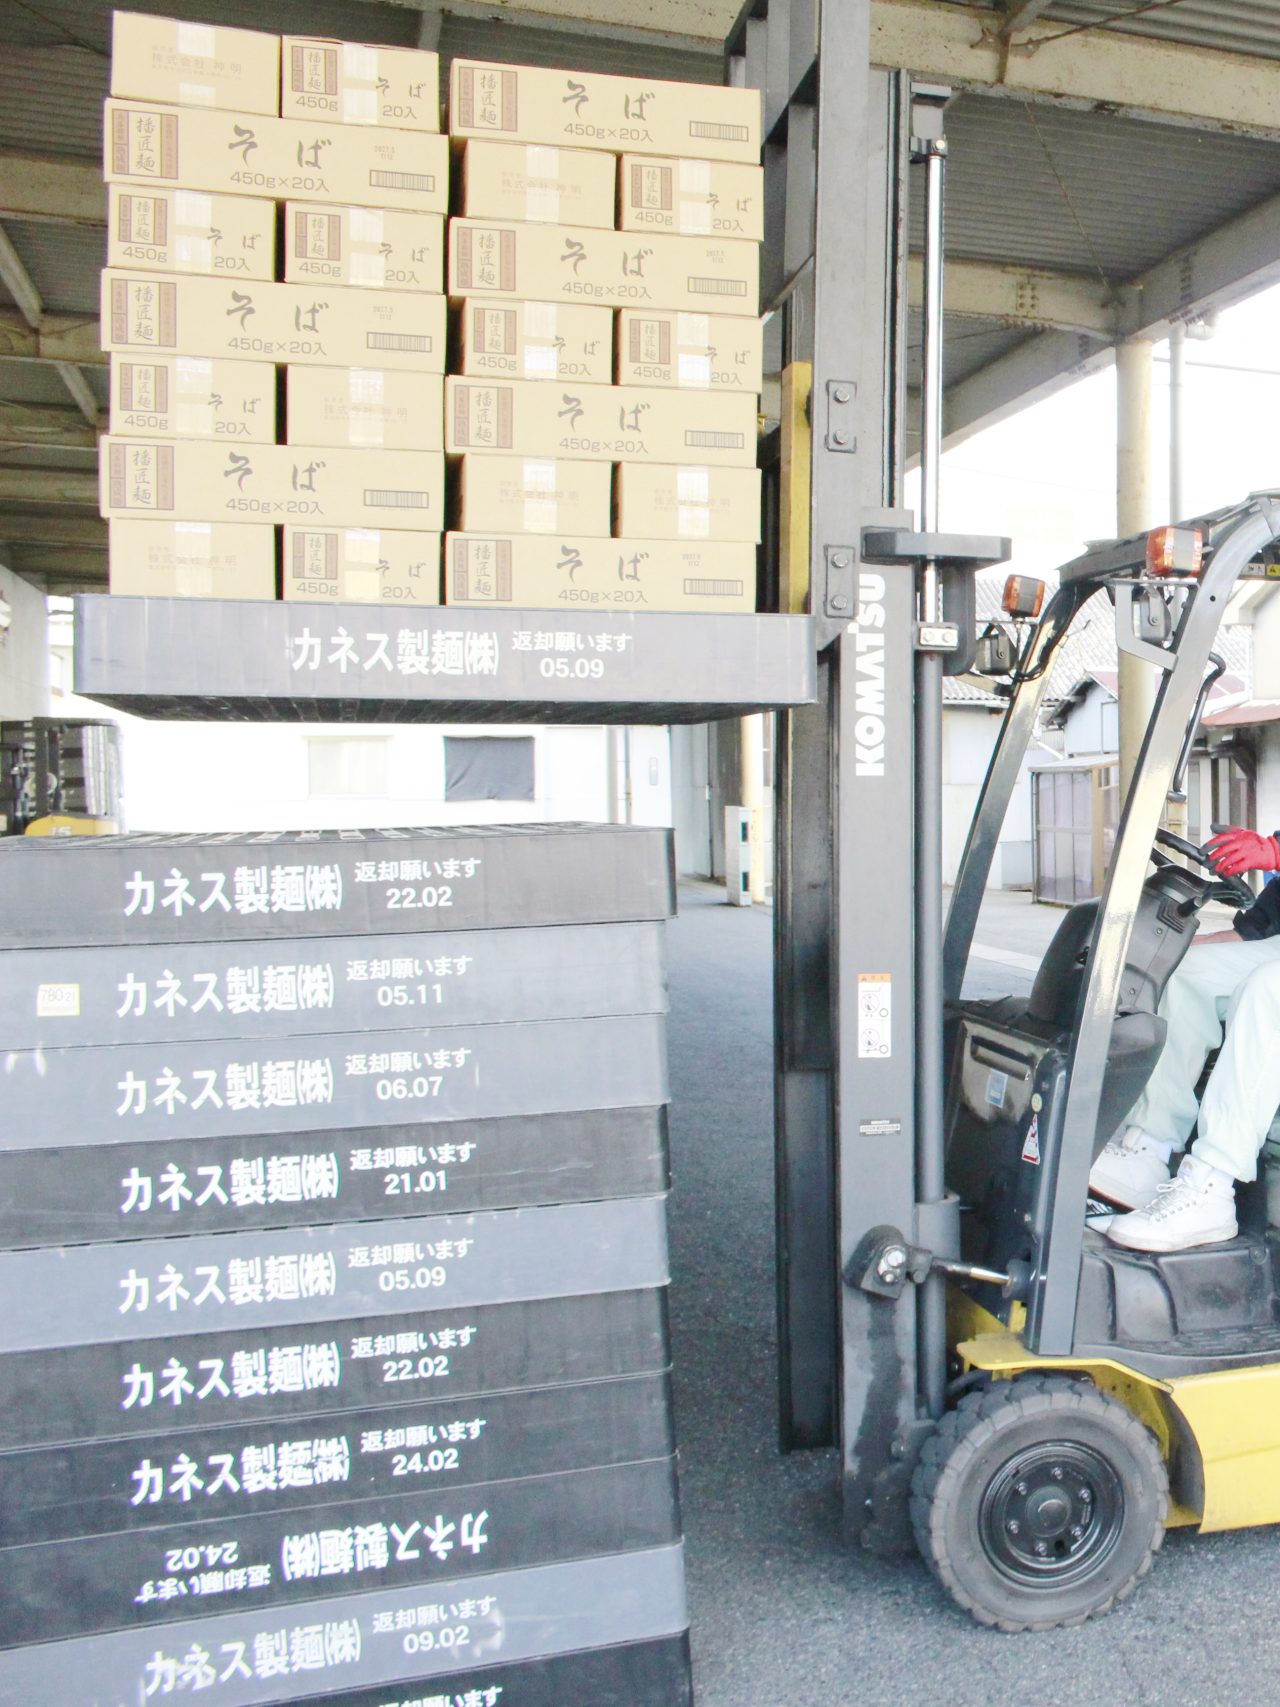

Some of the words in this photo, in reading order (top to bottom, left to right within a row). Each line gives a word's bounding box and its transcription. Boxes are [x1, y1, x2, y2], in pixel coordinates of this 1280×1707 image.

[375, 77, 427, 99] そば
[296, 95, 339, 112] 450g
[382, 104, 418, 120] 20入
[562, 79, 655, 122] そば
[563, 123, 654, 144] 450g×20入
[228, 124, 332, 169] そば
[230, 172, 330, 192] 450g×20入
[706, 192, 752, 213] そば
[635, 211, 673, 227] 450g
[712, 217, 745, 232] 20入
[207, 227, 261, 250] そば
[122, 246, 168, 263] 450g
[214, 256, 251, 271] 20入
[377, 242, 430, 263] そば
[560, 237, 654, 278] そば
[299, 262, 341, 278] 450g
[384, 269, 420, 284] 20入
[561, 282, 653, 300] 450g×20入
[226, 290, 329, 333] そば
[228, 337, 327, 356] 450g×20入
[552, 335, 601, 357] そば
[704, 346, 751, 366] そば
[477, 356, 517, 371] 450g
[559, 362, 593, 377] 20入
[632, 366, 672, 381] 450g
[711, 372, 743, 385] 20入
[207, 393, 261, 414] そば
[557, 393, 651, 433] そば
[124, 415, 169, 430] 450g
[214, 421, 251, 436] 20入
[559, 437, 649, 454] 450g×20入
[224, 451, 327, 492] そば
[225, 498, 324, 515] 450g×20入
[375, 560, 427, 579] そば
[557, 545, 650, 582] そば
[296, 582, 339, 596] 450g
[382, 586, 416, 599] 20入
[558, 588, 649, 604] 450g×20入
[512, 630, 632, 653] 返却願います
[540, 658, 604, 680] 05.09
[850, 574, 885, 776] KOMATSU
[354, 857, 481, 883] 返却願います
[385, 887, 453, 909] 22.02
[346, 955, 472, 982] 返却願います
[377, 984, 443, 1007] 05.11
[345, 1048, 472, 1076] 返却願います
[376, 1076, 443, 1100] 06.07
[350, 1141, 477, 1170] 返却願います
[384, 1171, 449, 1194] 21.01
[348, 1238, 474, 1268] 返却願います
[379, 1267, 447, 1292] 05.09
[351, 1326, 477, 1359] 返却願います
[383, 1356, 450, 1382] 22.02
[361, 1419, 487, 1453] 返却願います
[392, 1449, 459, 1476] 24.02
[166, 1542, 239, 1569] 24.02
[135, 1564, 271, 1604] 返却願います
[372, 1597, 497, 1633] 返却願います
[403, 1625, 470, 1653] 09.02
